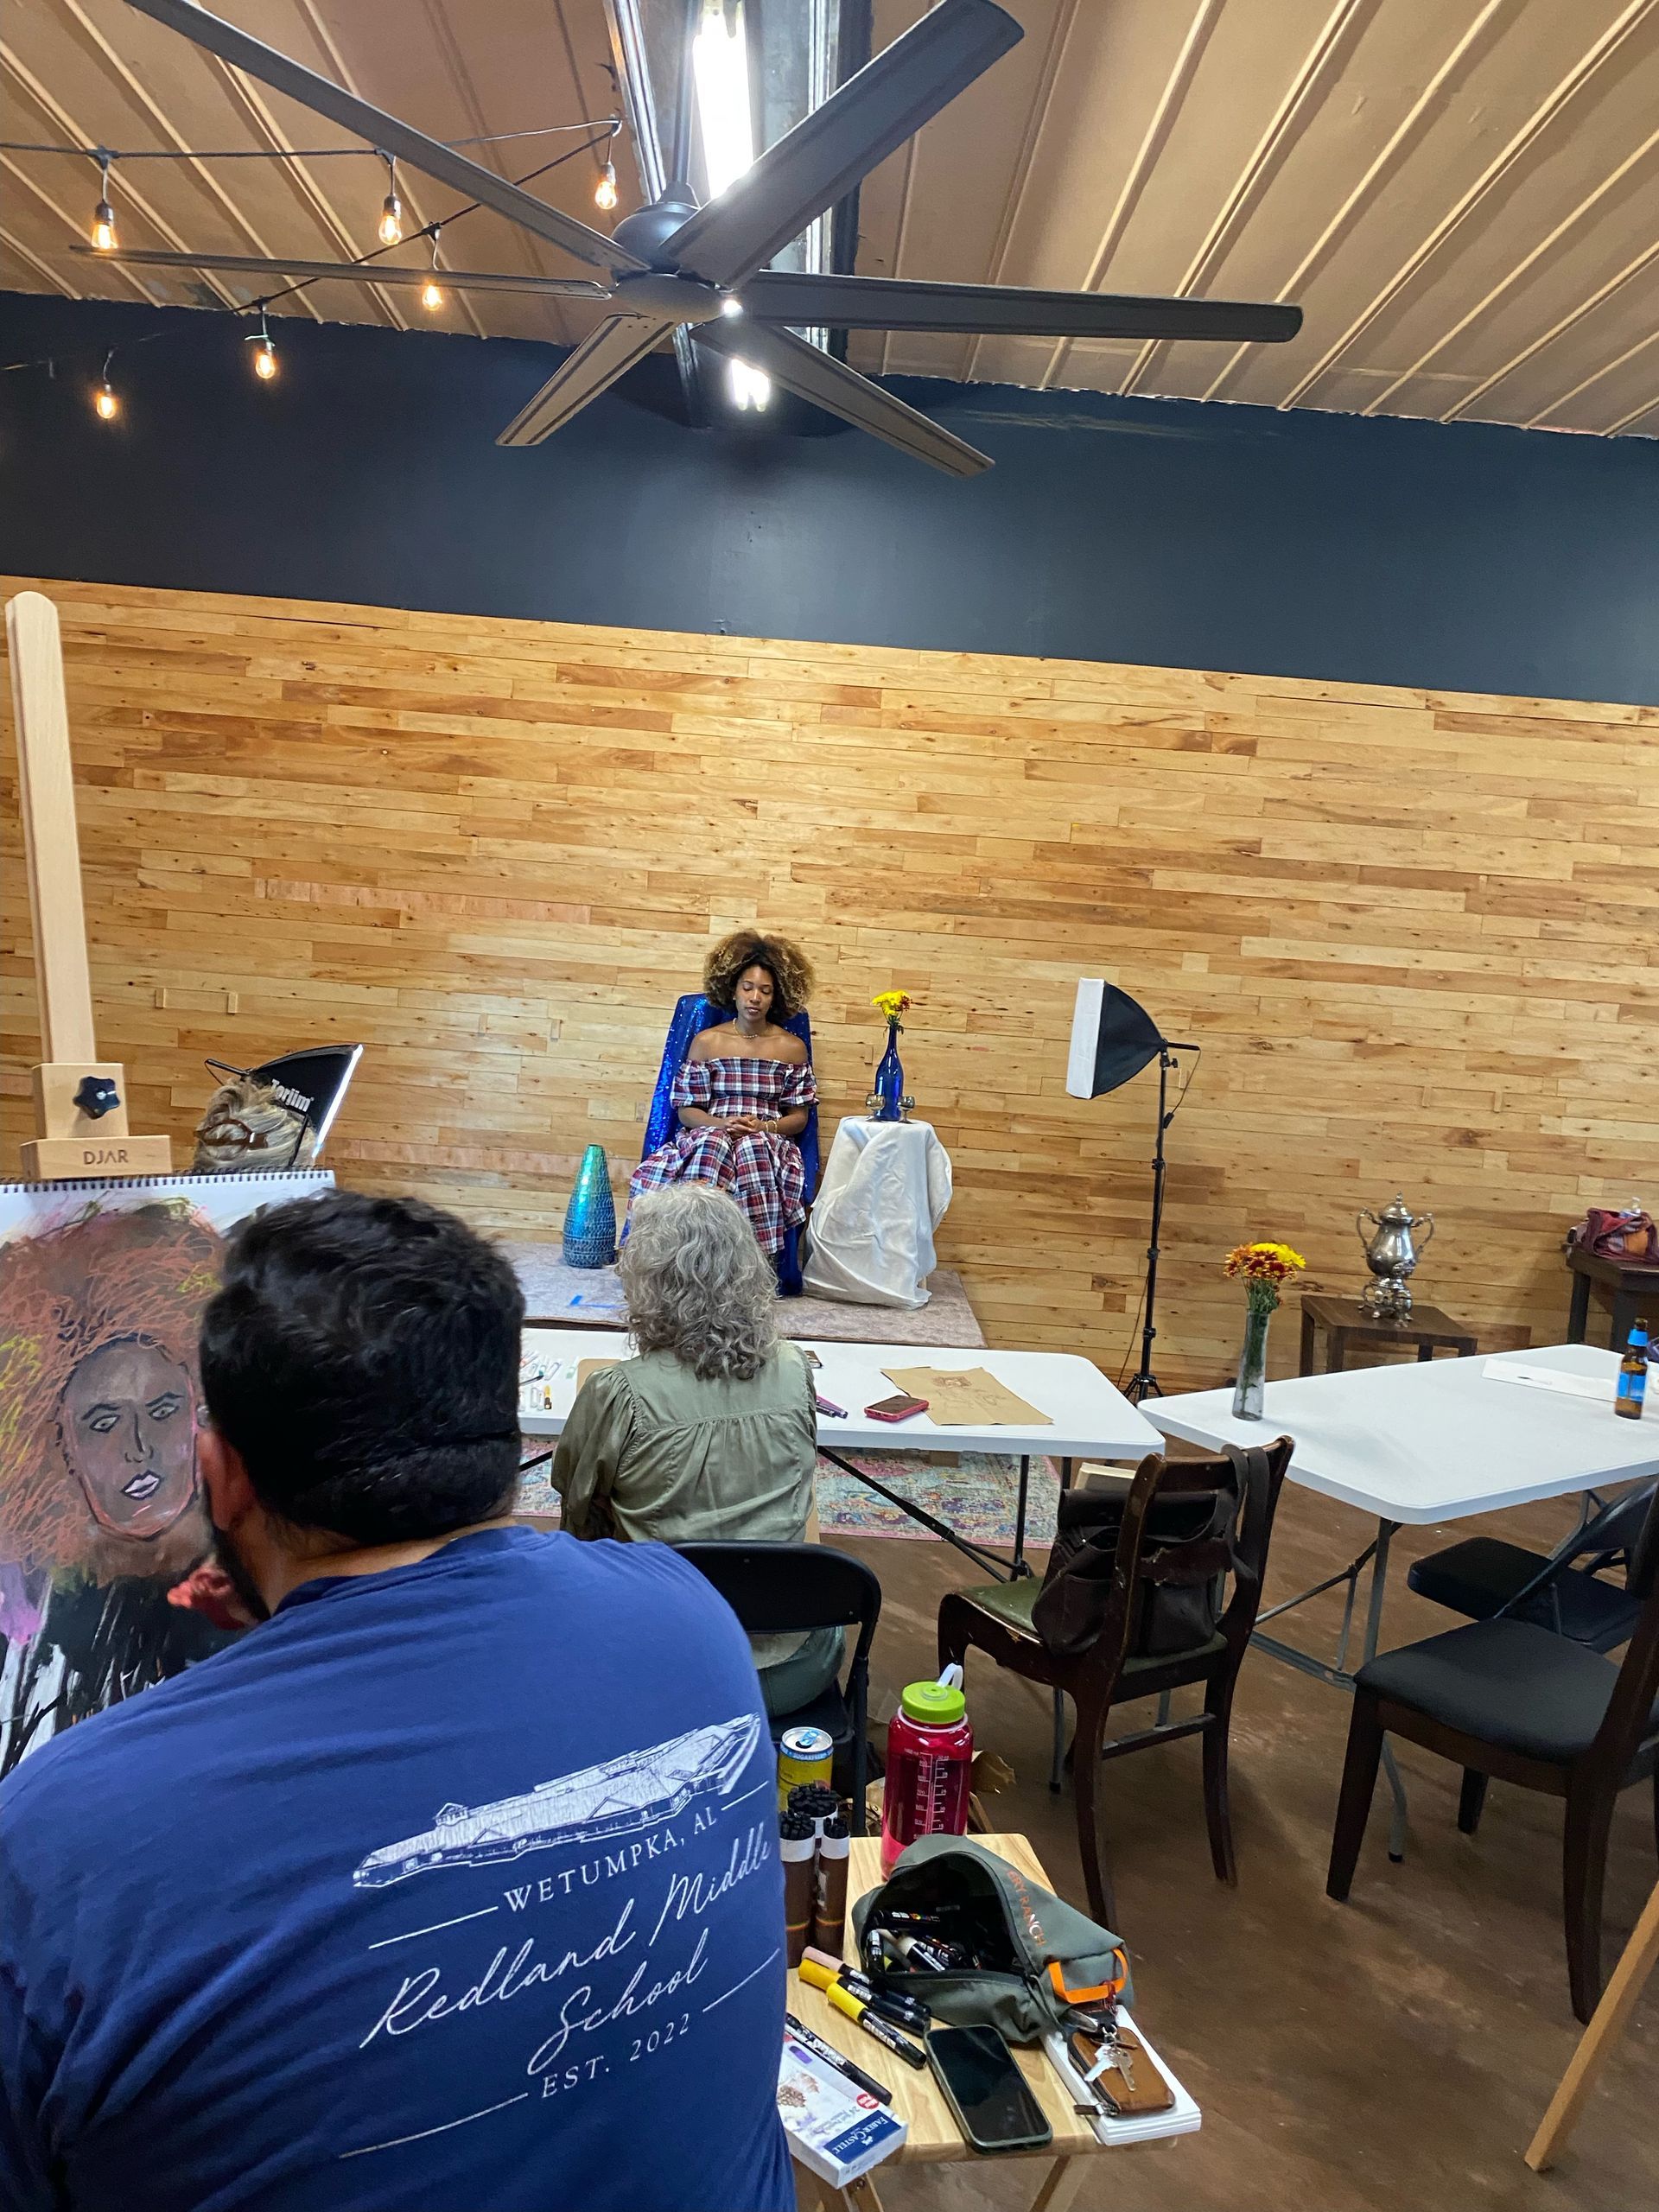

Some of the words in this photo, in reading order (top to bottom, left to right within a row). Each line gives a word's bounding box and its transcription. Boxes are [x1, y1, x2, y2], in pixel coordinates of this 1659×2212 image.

[83, 1149, 129, 1165] DJAR
[503, 1827, 685, 1913] WETUMPKA,
[694, 1807, 717, 1835] AL
[359, 1898, 637, 2048] Redland
[649, 1821, 772, 1946] Middle
[1020, 1896, 1047, 1947] RANCH
[527, 1927, 709, 2075] School
[541, 2056, 609, 2098] EST.
[630, 2013, 690, 2062] 2022
